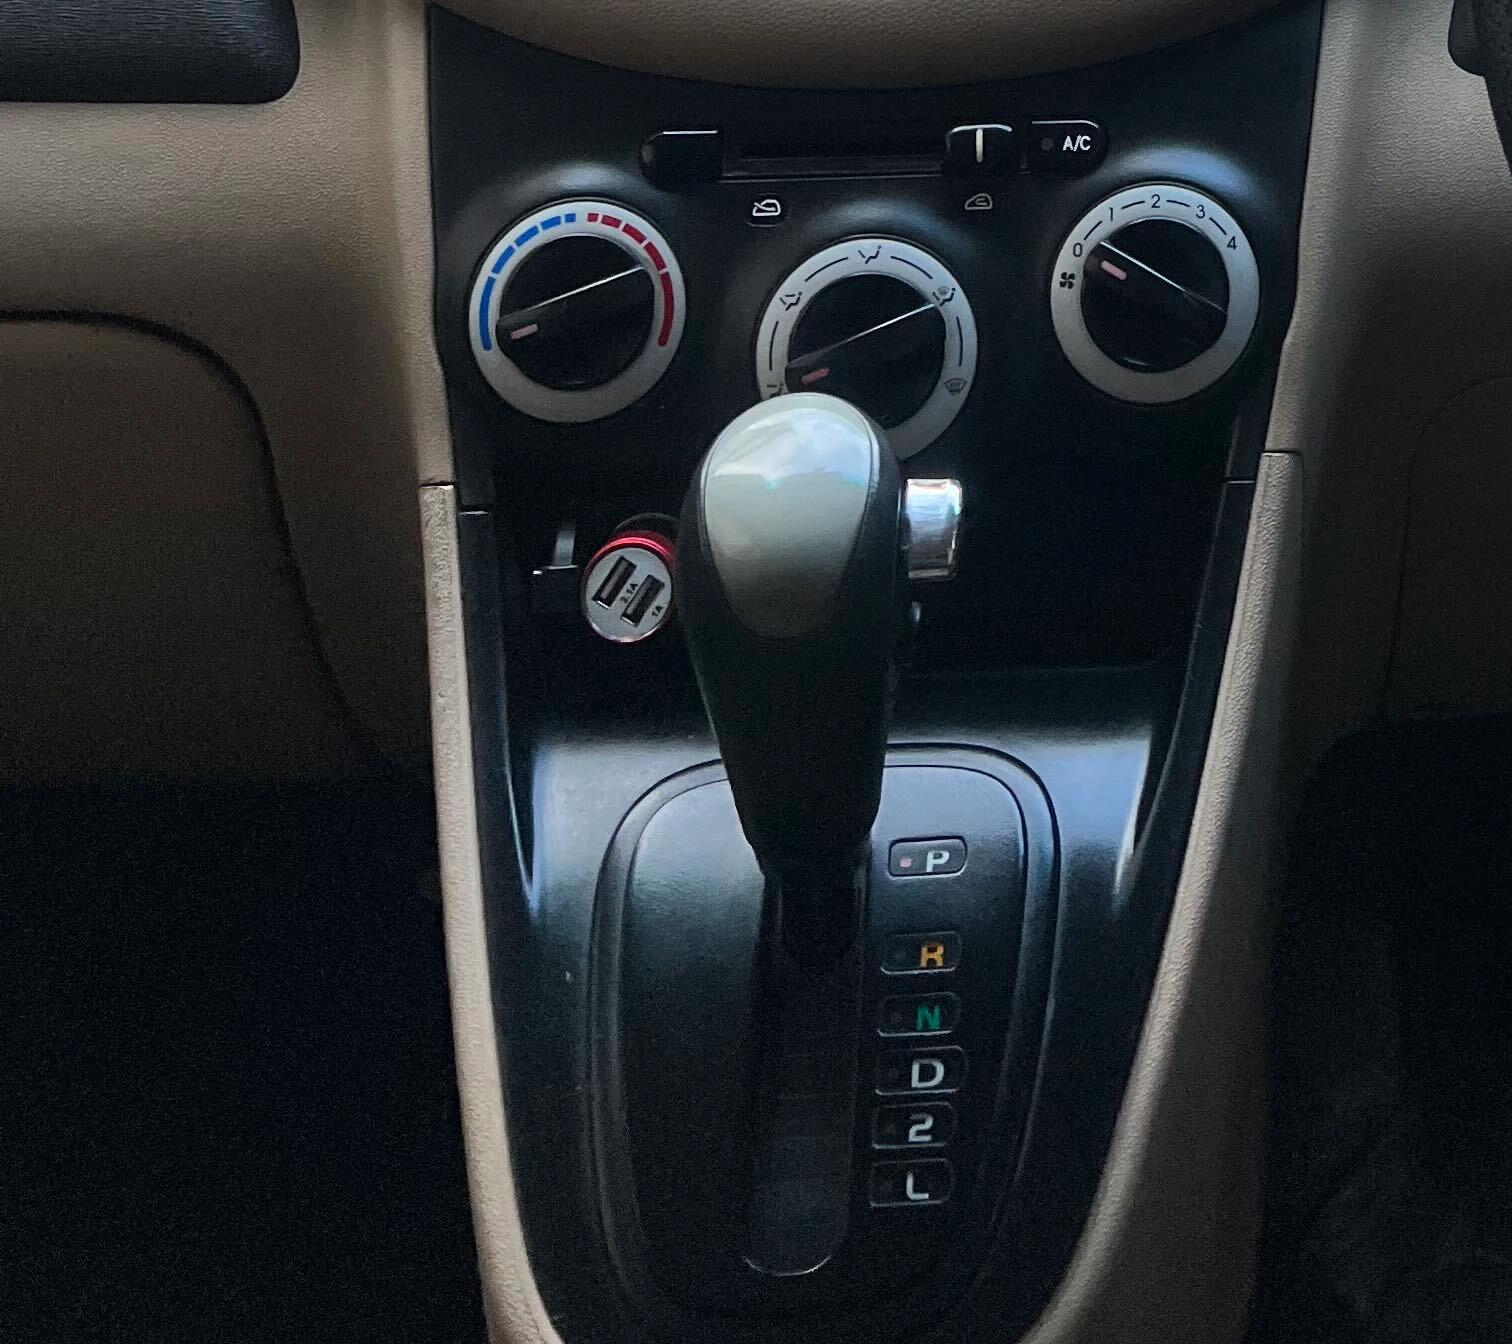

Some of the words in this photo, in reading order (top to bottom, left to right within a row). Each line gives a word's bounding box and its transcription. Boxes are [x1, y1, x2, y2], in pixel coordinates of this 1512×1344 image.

[1062, 135, 1092, 152] A/C
[1151, 194, 1161, 208] 2
[1108, 207, 1114, 222] 1
[1196, 205, 1206, 219] 3
[1072, 242, 1084, 258] 0
[1227, 235, 1238, 250] 4
[652, 605, 664, 617] 1A
[925, 850, 950, 873] P
[920, 942, 944, 968] R
[915, 1005, 942, 1031] N
[910, 1058, 945, 1089] D
[908, 1113, 934, 1143] 2
[905, 1172, 930, 1199] L
